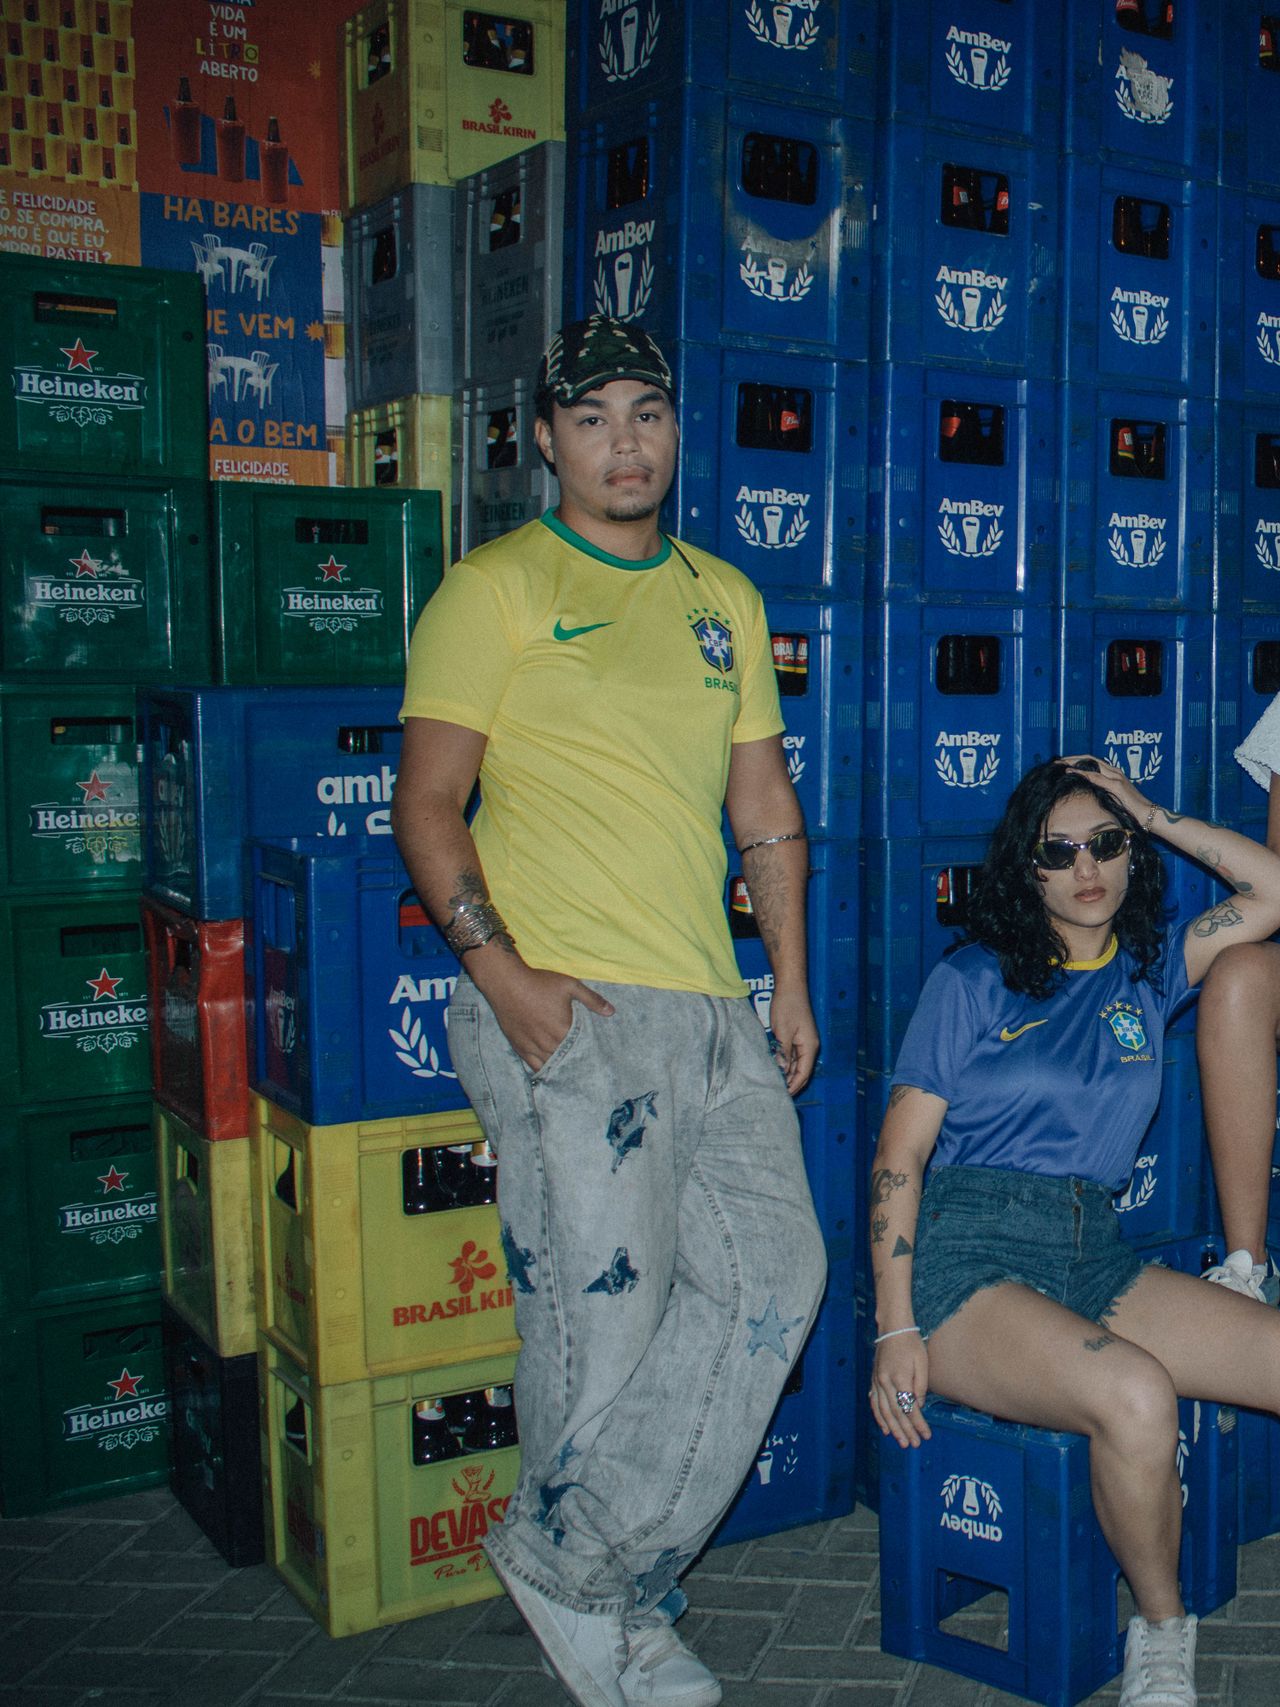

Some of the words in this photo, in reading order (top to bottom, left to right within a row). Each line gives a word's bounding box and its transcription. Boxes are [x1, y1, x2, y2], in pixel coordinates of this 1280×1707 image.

[210, 4, 245, 23] VIDA
[223, 25, 247, 41] UM
[945, 25, 1012, 54] AmBev
[200, 60, 258, 82] ABERTO
[462, 119, 503, 137] BRASIL
[503, 126, 537, 140] KIRIN
[13, 191, 97, 215] FELICIDADE
[17, 209, 34, 224] SE
[214, 200, 299, 236] BARES
[48, 229, 79, 246] QUE
[84, 232, 104, 248] EU
[593, 218, 656, 258] AmBev
[46, 245, 112, 264] PASTEL?
[935, 264, 1008, 291] AmBev
[1110, 286, 1170, 310] AmBev
[239, 312, 295, 340] VEM
[20, 372, 139, 401] Heineken
[237, 418, 256, 444] O
[264, 419, 318, 447] BEM
[215, 459, 289, 477] FELICIDADE
[735, 485, 811, 508] AmBev
[938, 497, 1004, 519] AmBev
[1108, 512, 1167, 532] AmBev
[34, 581, 137, 601] Heineken
[287, 593, 378, 611] Heineken
[935, 730, 1001, 748] AmBev
[1104, 729, 1163, 747] AmBev
[317, 766, 397, 804] amb
[37, 809, 140, 830] Heineke
[48, 1004, 147, 1031] Heineke
[1120, 1053, 1156, 1063] BRASIL
[393, 1295, 478, 1326] BRASIL
[69, 1401, 167, 1434] Heineke
[939, 1511, 1004, 1543] ambev
